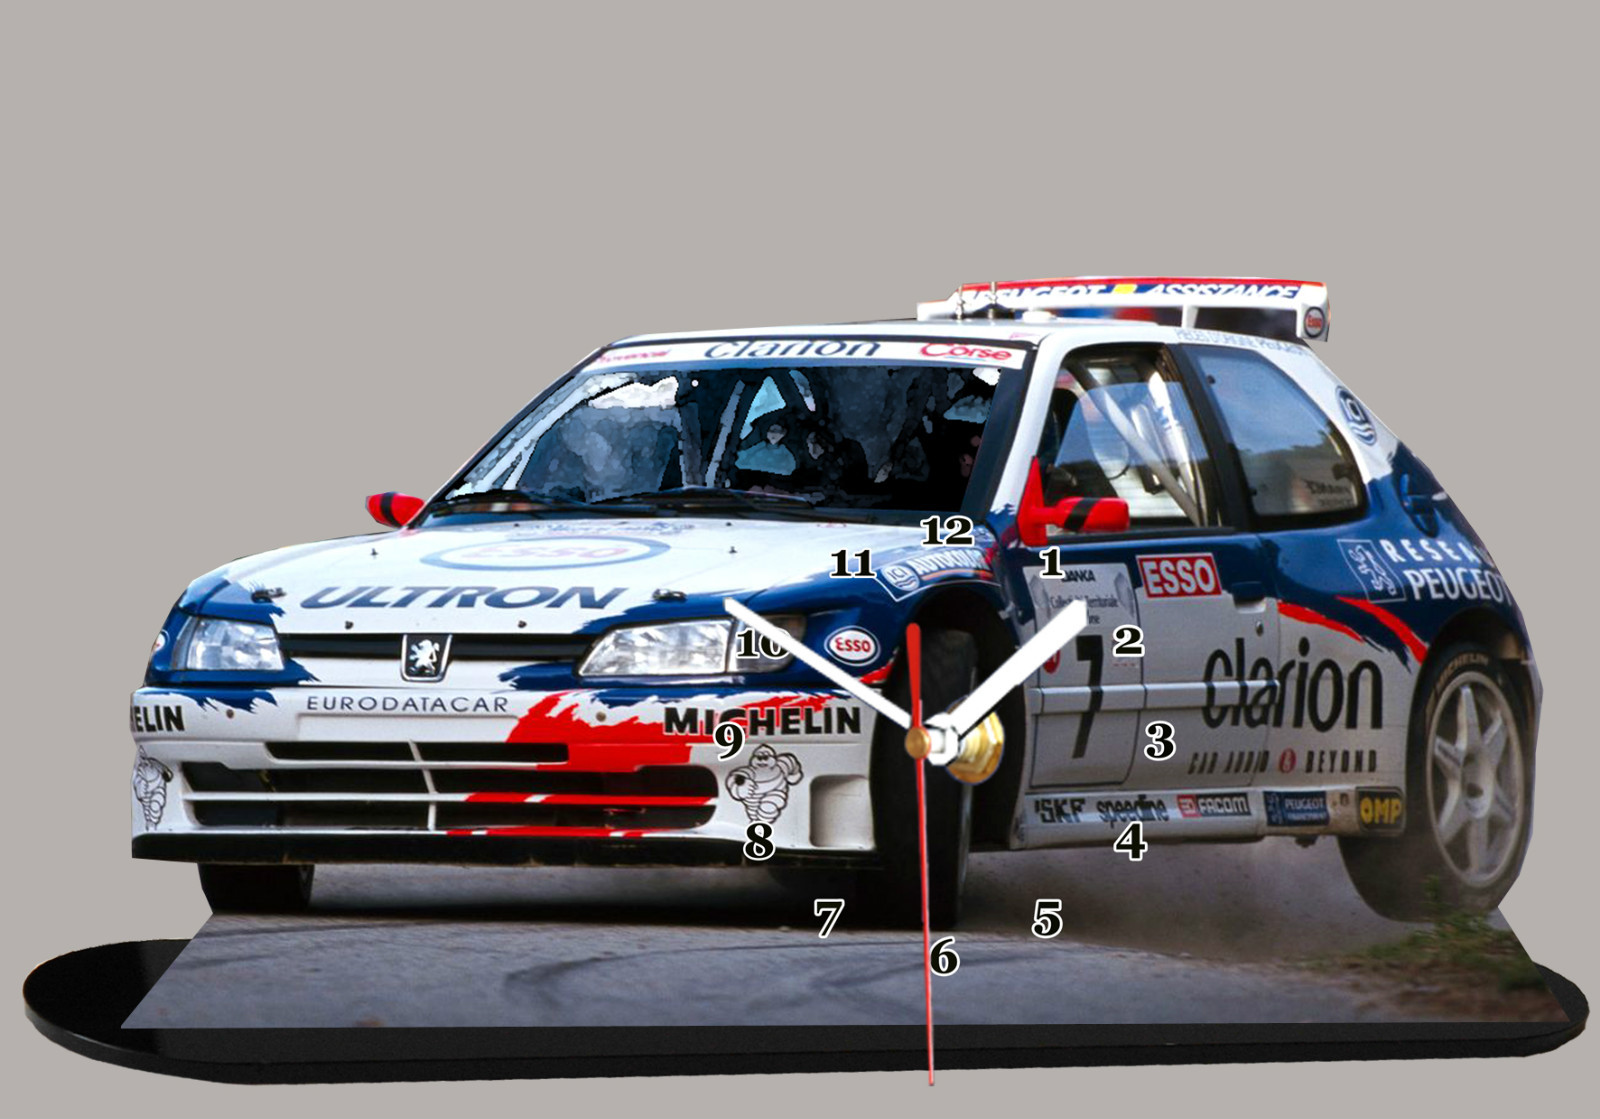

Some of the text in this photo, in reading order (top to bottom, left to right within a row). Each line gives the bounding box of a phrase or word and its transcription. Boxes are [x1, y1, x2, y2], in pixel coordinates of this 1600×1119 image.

[919, 342, 1012, 361] Corse
[1141, 558, 1216, 595] ESSO
[299, 586, 630, 610] ULTRON
[307, 696, 508, 713] EURODATACAR
[1072, 634, 1104, 759] 7
[664, 707, 862, 735] MICHELIN
[1305, 750, 1377, 774] BEYOND
[1039, 797, 1085, 823] SKF
[1199, 795, 1249, 814] FACOM
[1360, 797, 1401, 825] OMP
